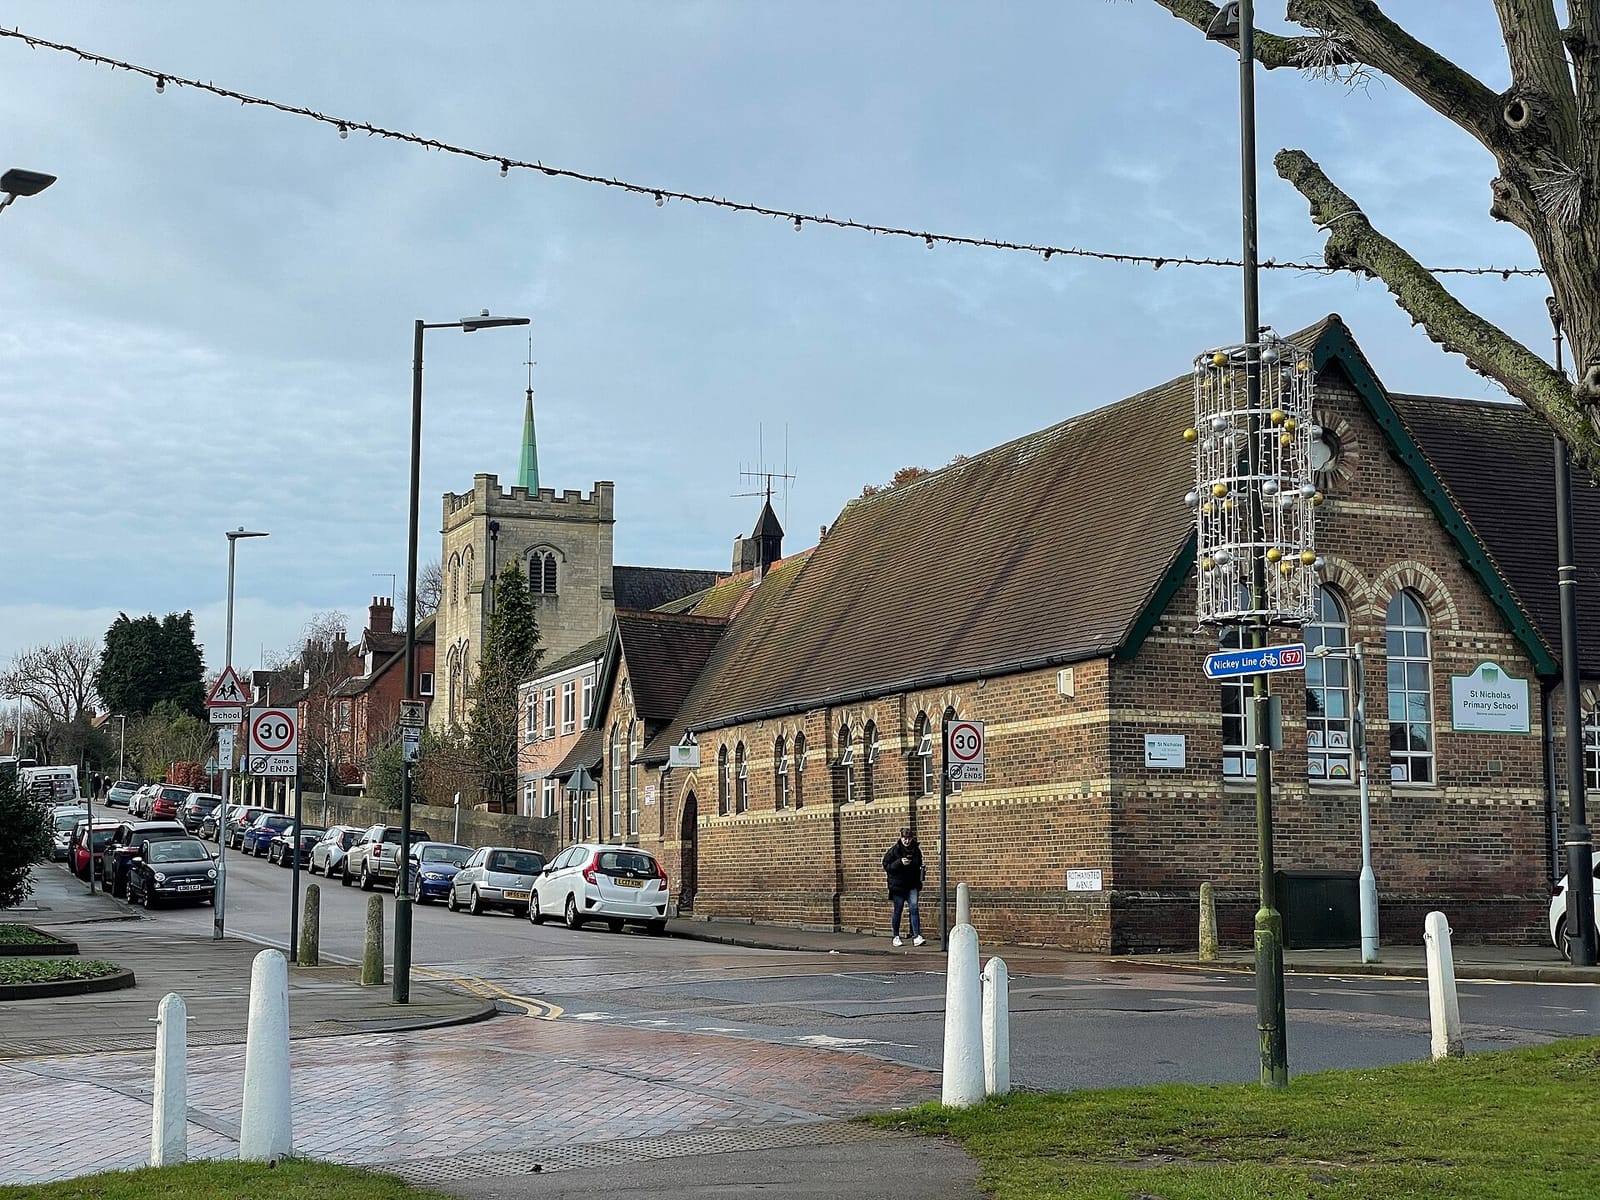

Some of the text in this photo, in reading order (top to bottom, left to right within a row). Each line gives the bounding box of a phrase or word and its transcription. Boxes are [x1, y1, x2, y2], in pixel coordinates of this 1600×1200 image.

[1213, 660, 1240, 670] Nickey
[1241, 657, 1258, 667] Line
[1470, 690, 1511, 699] St Nicholas
[1463, 701, 1519, 711] Primary School
[212, 711, 241, 719] School
[259, 723, 289, 740] 30
[955, 734, 978, 750] 30
[270, 765, 295, 773] ENDS
